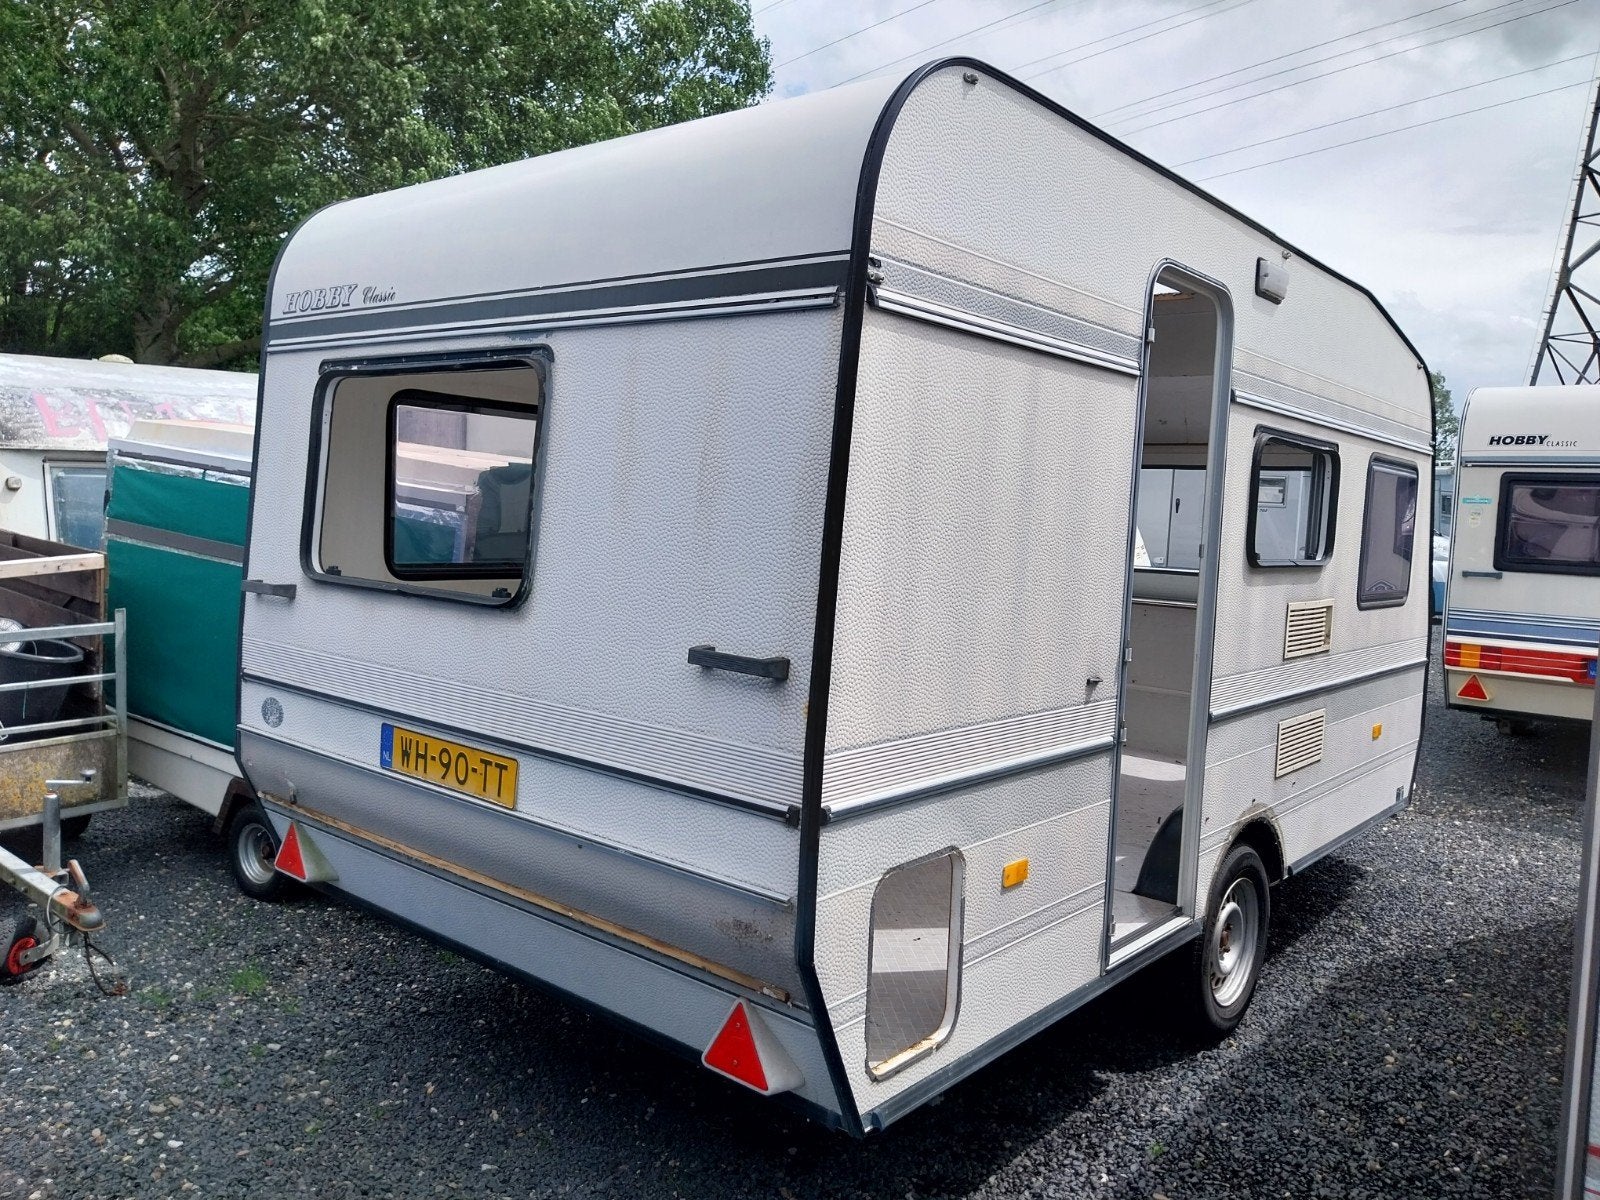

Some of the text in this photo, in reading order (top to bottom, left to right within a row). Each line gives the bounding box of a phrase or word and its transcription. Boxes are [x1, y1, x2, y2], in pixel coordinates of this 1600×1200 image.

[283, 283, 396, 314] HOBBY Classic
[1489, 435, 1548, 446] HOBBY
[383, 735, 508, 797] NL WH-90-TT
